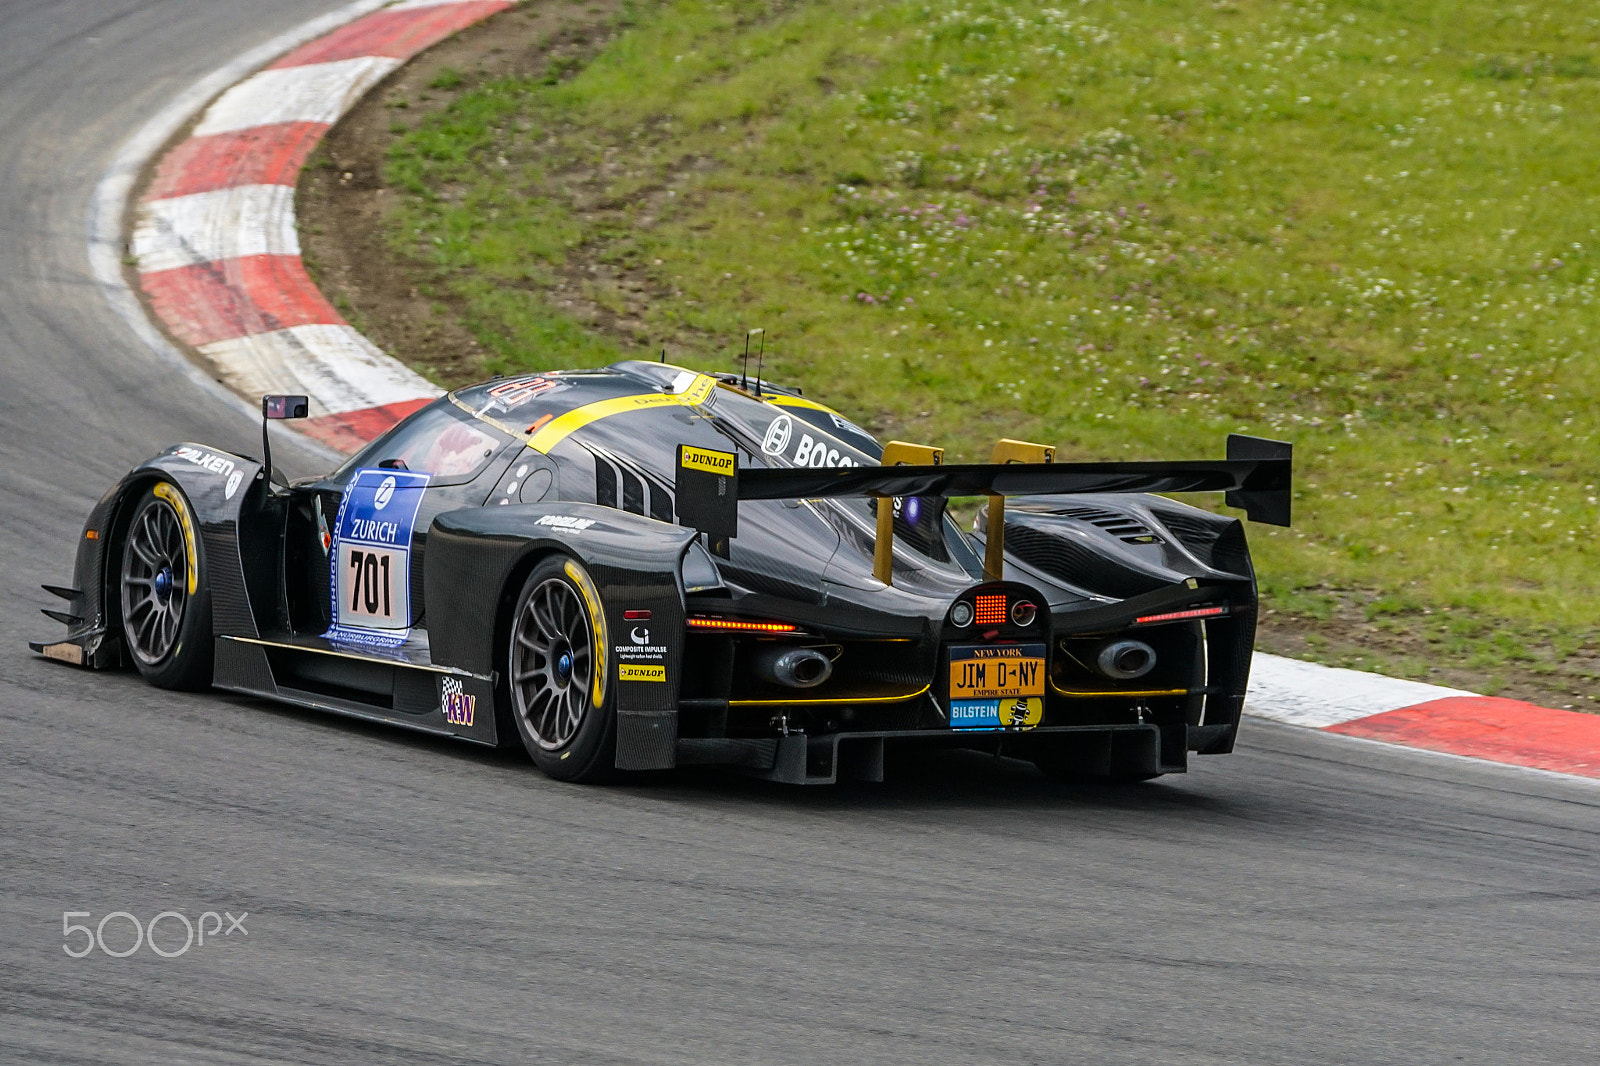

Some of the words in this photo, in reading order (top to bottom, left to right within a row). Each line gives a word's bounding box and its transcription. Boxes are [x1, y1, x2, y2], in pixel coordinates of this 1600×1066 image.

[692, 453, 732, 468] DUNLOP
[793, 433, 859, 468] BOS
[350, 518, 397, 542] ZURICH
[351, 550, 390, 616] 701
[974, 649, 995, 657] NEW
[996, 648, 1023, 657] YORK
[628, 669, 664, 677] DUNLOP
[956, 663, 986, 688] JIM
[447, 692, 476, 727] KW
[952, 705, 998, 718] BILSTEIN
